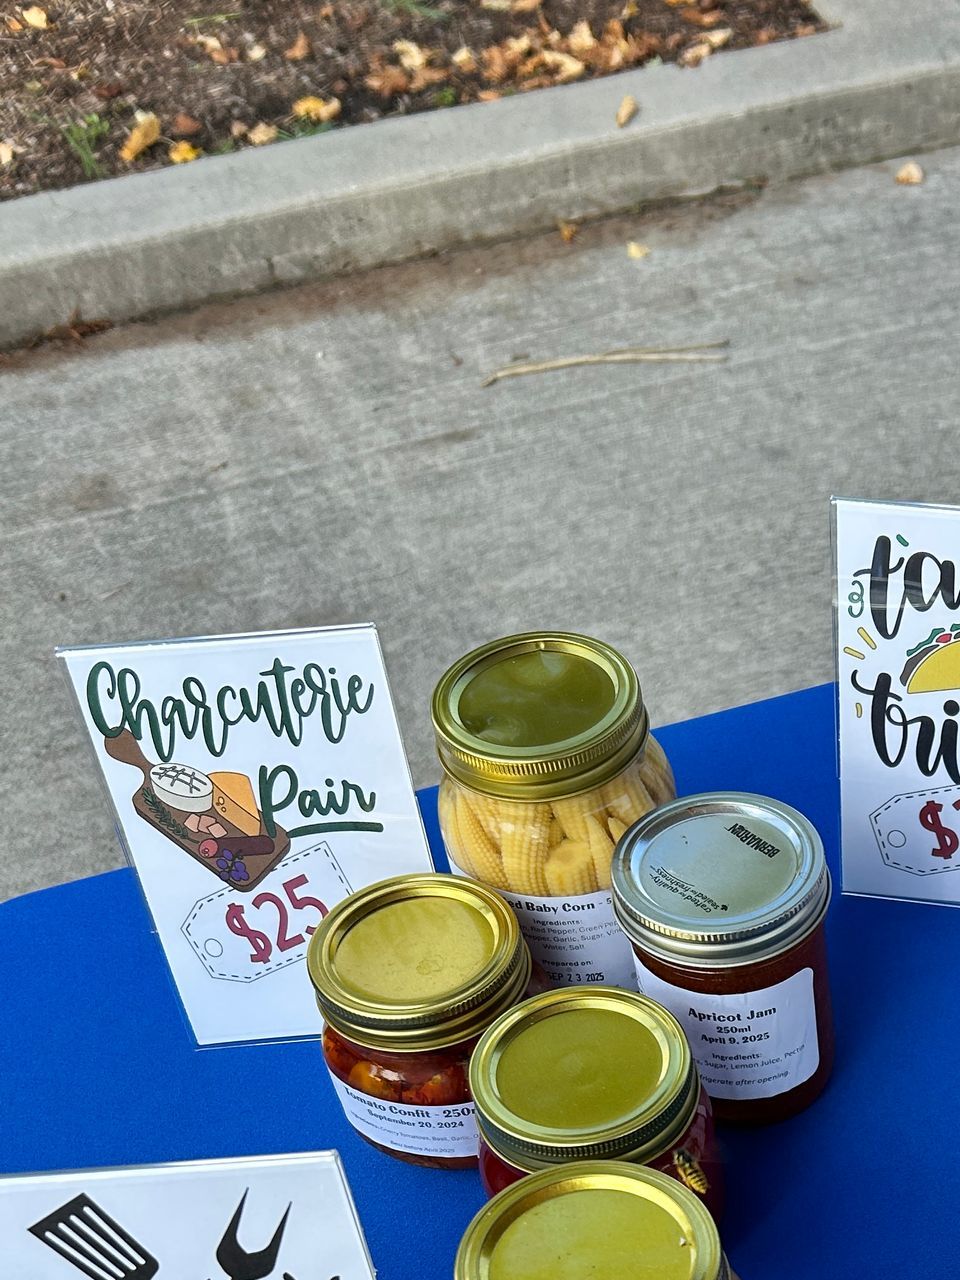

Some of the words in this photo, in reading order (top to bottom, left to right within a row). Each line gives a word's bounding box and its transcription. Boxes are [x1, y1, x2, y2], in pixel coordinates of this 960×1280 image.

[86, 657, 374, 762] Charcuterie
[258, 764, 376, 838] Pair
[727, 822, 780, 859] BERNARDIN
[526, 901, 559, 915] Baby
[562, 902, 595, 912] Corn
[683, 893, 712, 914] crafted
[697, 888, 720, 910] sealed
[225, 874, 330, 964] $25
[533, 918, 583, 926] Ingredients:
[586, 971, 605, 982] 2025
[688, 1007, 742, 1022] Apricot
[746, 1007, 777, 1021] Jam
[716, 1024, 752, 1034] 250ml
[701, 1034, 726, 1045] April
[742, 1032, 770, 1044] 2025
[704, 1059, 729, 1071] Sugar,
[760, 1057, 782, 1069] Juice,
[712, 1052, 762, 1062] Ingredients:
[344, 1086, 387, 1112] Tomato
[388, 1105, 431, 1119] Confit
[367, 1108, 416, 1128] September
[437, 1121, 464, 1129] 2024
